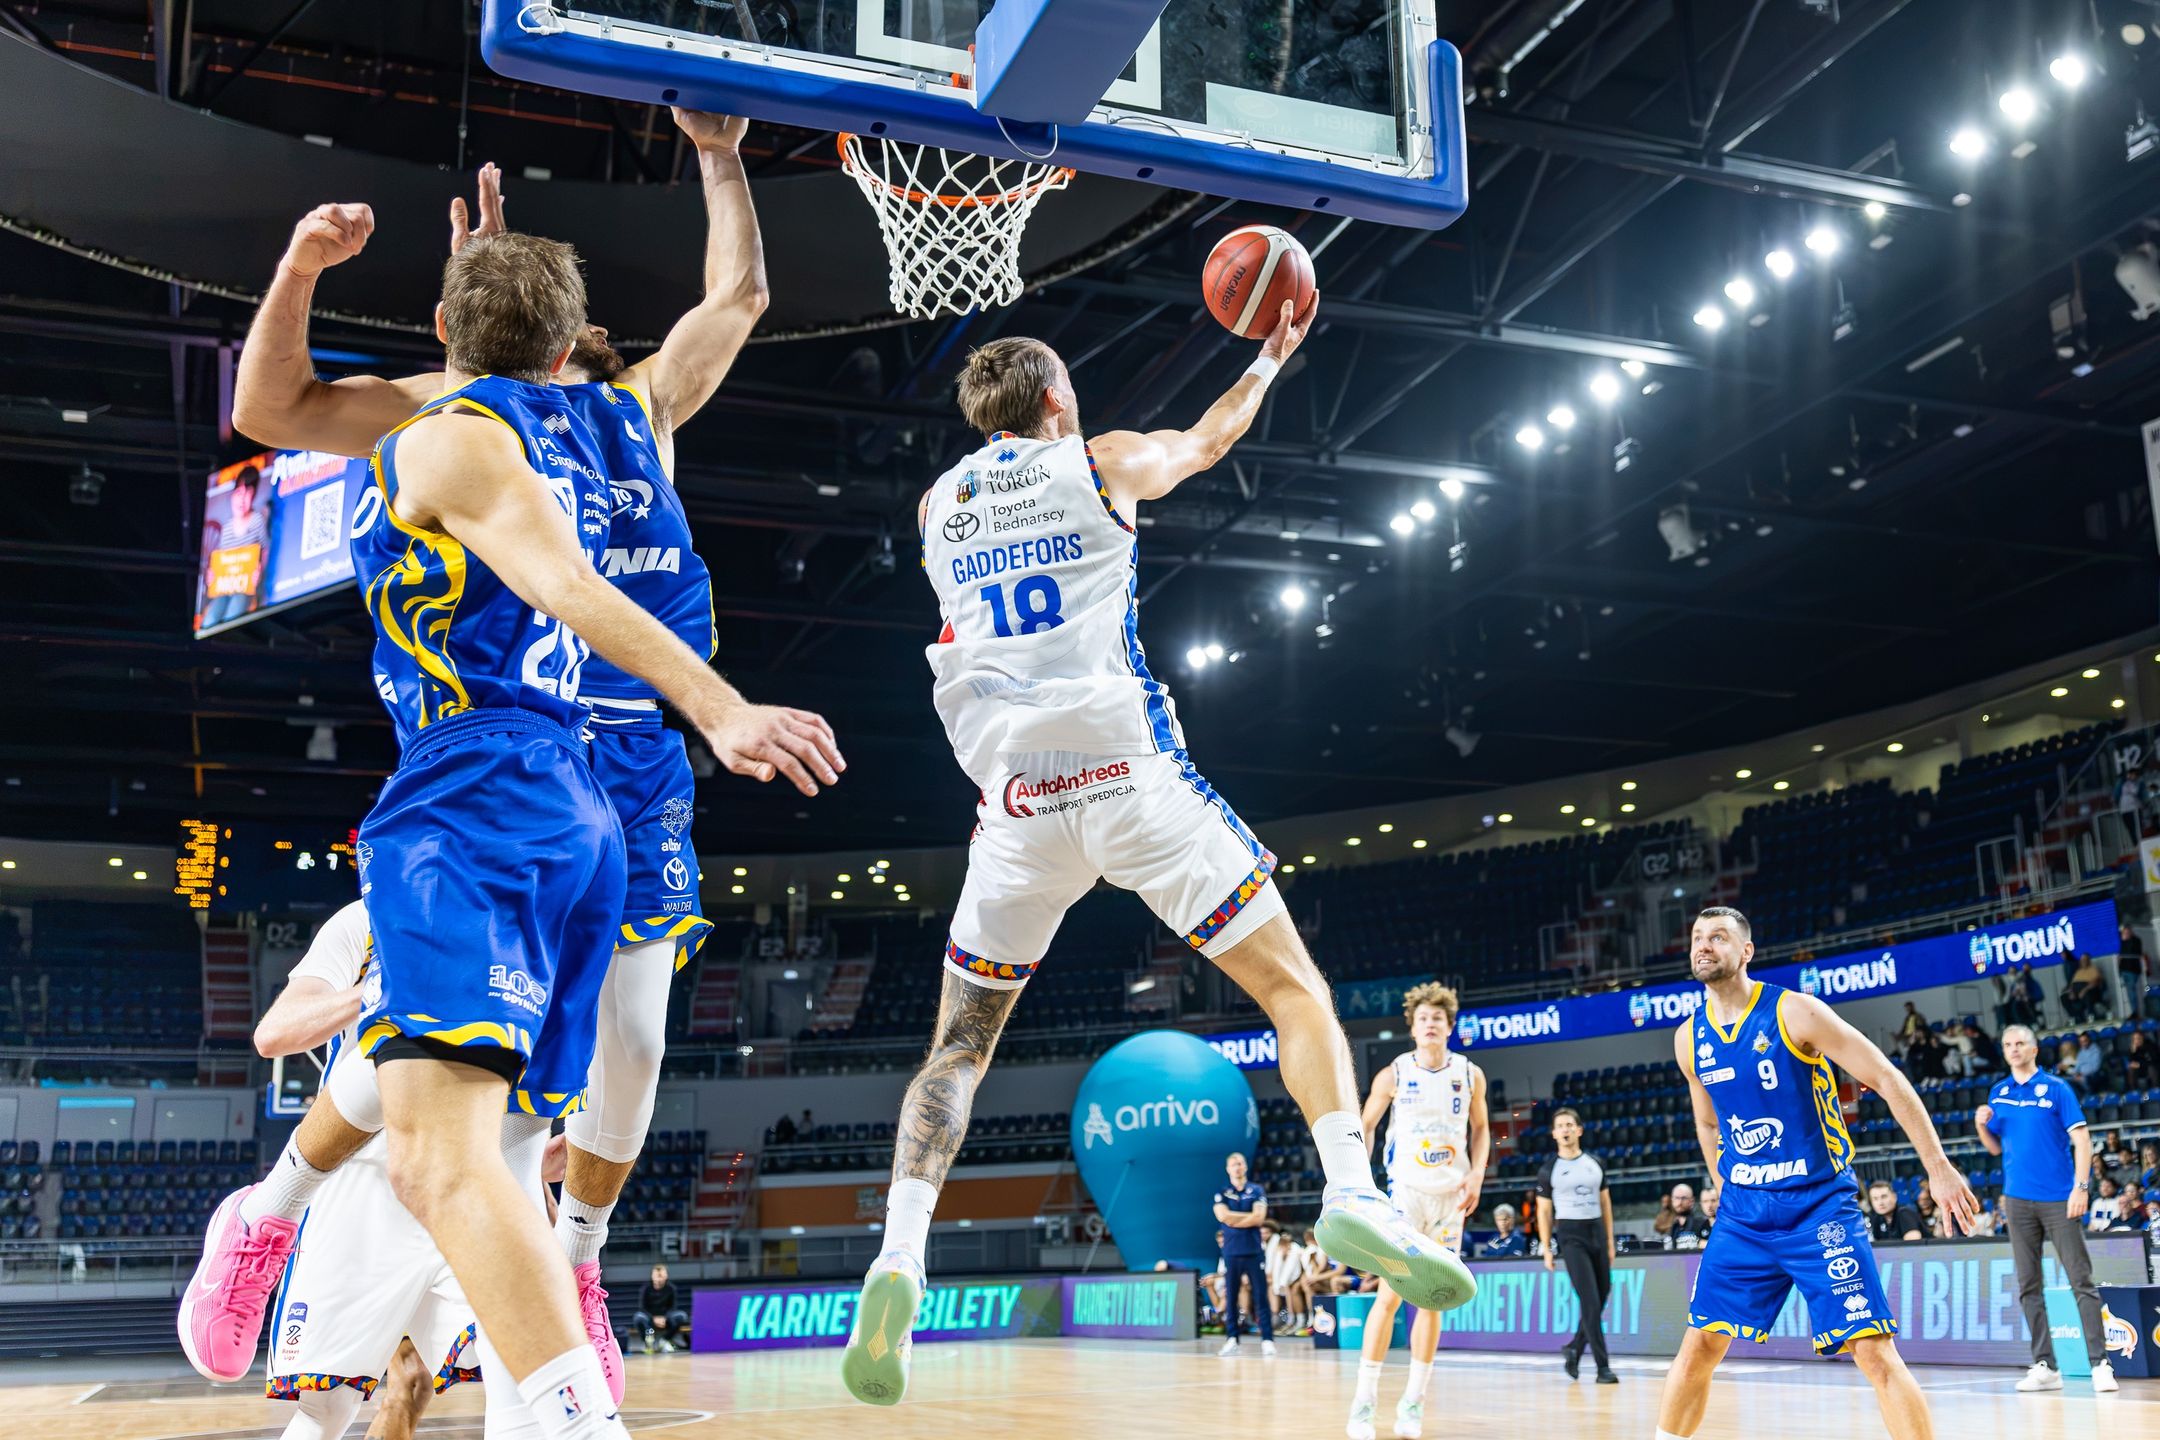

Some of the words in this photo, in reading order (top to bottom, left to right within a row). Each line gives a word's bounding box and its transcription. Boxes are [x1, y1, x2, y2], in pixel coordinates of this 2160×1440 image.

[1220, 265, 1246, 311] molten
[987, 464, 1043, 480] MIASTO
[990, 499, 1036, 516] Toyota
[994, 510, 1065, 533] Bednarscy
[952, 533, 1083, 585] GADDEFORS
[980, 575, 1066, 637] 18
[522, 610, 590, 702] 20
[2114, 744, 2141, 774] H2
[1016, 761, 1131, 800] AutoAndreas
[1037, 798, 1083, 816] TRANSPORT
[1087, 784, 1136, 804] SPEDYCJA
[1643, 853, 1669, 876] G2
[663, 901, 692, 912] WALDER
[1991, 915, 2075, 965] TORUŃ
[1819, 952, 1897, 996] TORUŃ
[1650, 990, 1709, 1020] TOR
[1479, 1005, 1560, 1040] TORUŃ
[1208, 1031, 1277, 1064] RUŃ
[1757, 1059, 1778, 1090] 9
[1115, 1094, 1219, 1131] arriva
[1453, 1097, 1461, 1114] 8
[1736, 1124, 1771, 1149] LOTTO
[1730, 1159, 1808, 1185] GDYNIA
[1085, 1214, 1110, 1238] G
[1823, 1246, 1854, 1259] albinos
[1539, 1271, 1549, 1333] I
[1552, 1269, 1646, 1334] BITY
[1832, 1283, 1864, 1296] WALDER
[1902, 1262, 1913, 1340] I
[1923, 1258, 2069, 1341] BILE
[733, 1291, 862, 1339] KARNET
[912, 1285, 1022, 1331] BILETY
[1846, 1309, 1872, 1321] errea
[2107, 1327, 2128, 1342] OTTO
